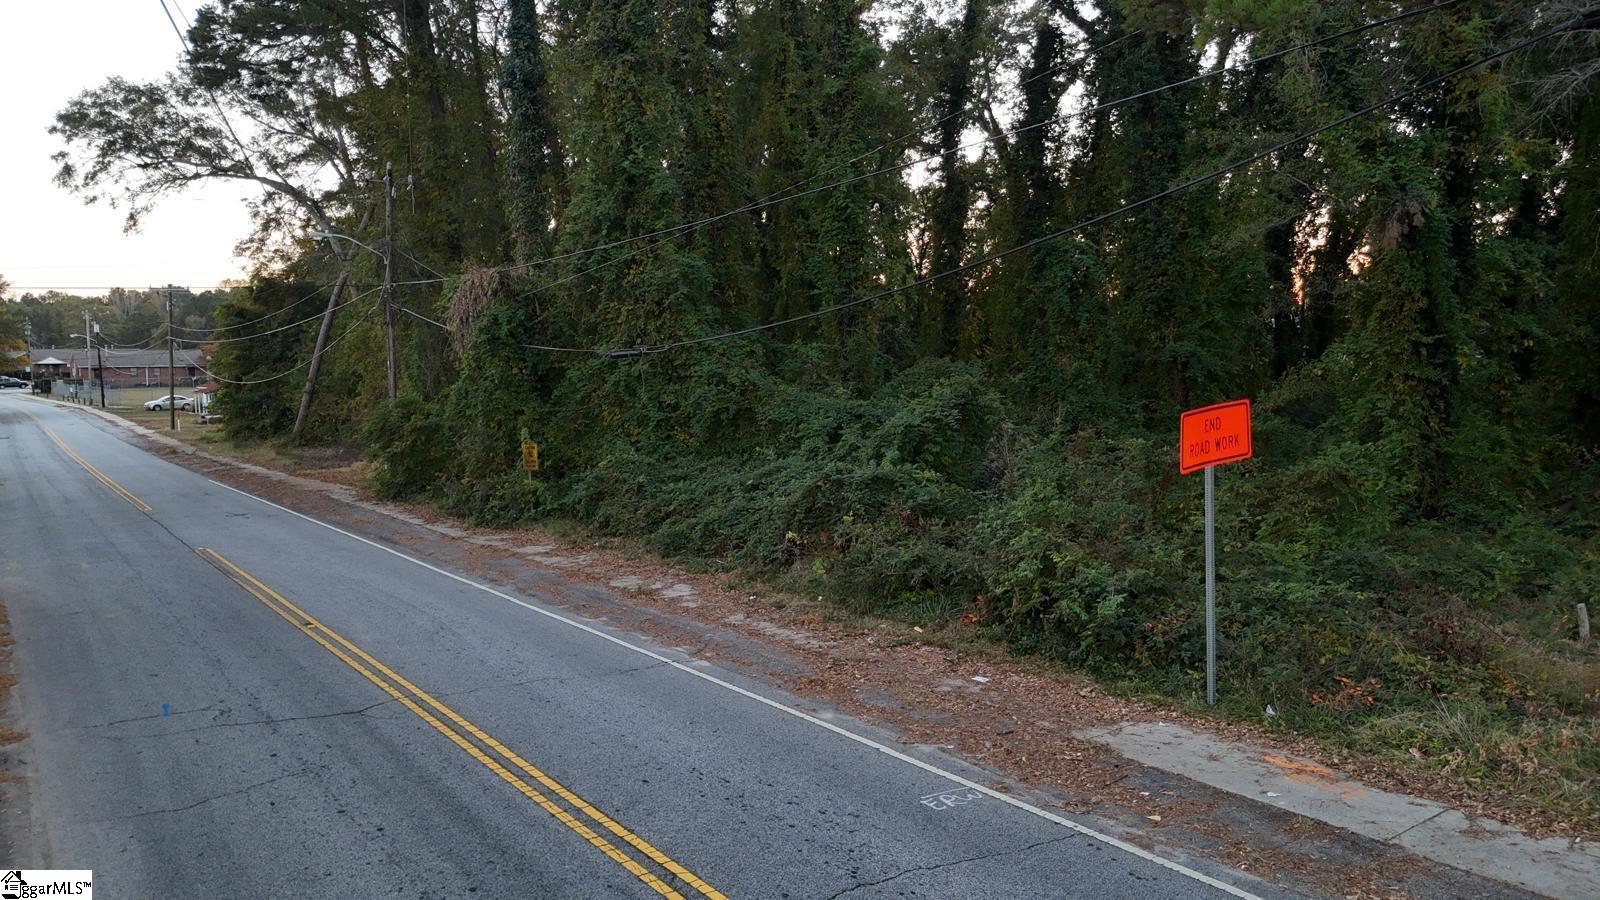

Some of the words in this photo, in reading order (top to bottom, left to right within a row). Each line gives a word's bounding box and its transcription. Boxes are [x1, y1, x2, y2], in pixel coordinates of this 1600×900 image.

[1204, 416, 1222, 433] END
[1189, 440, 1210, 458] ROAD
[1214, 434, 1240, 452] WORK
